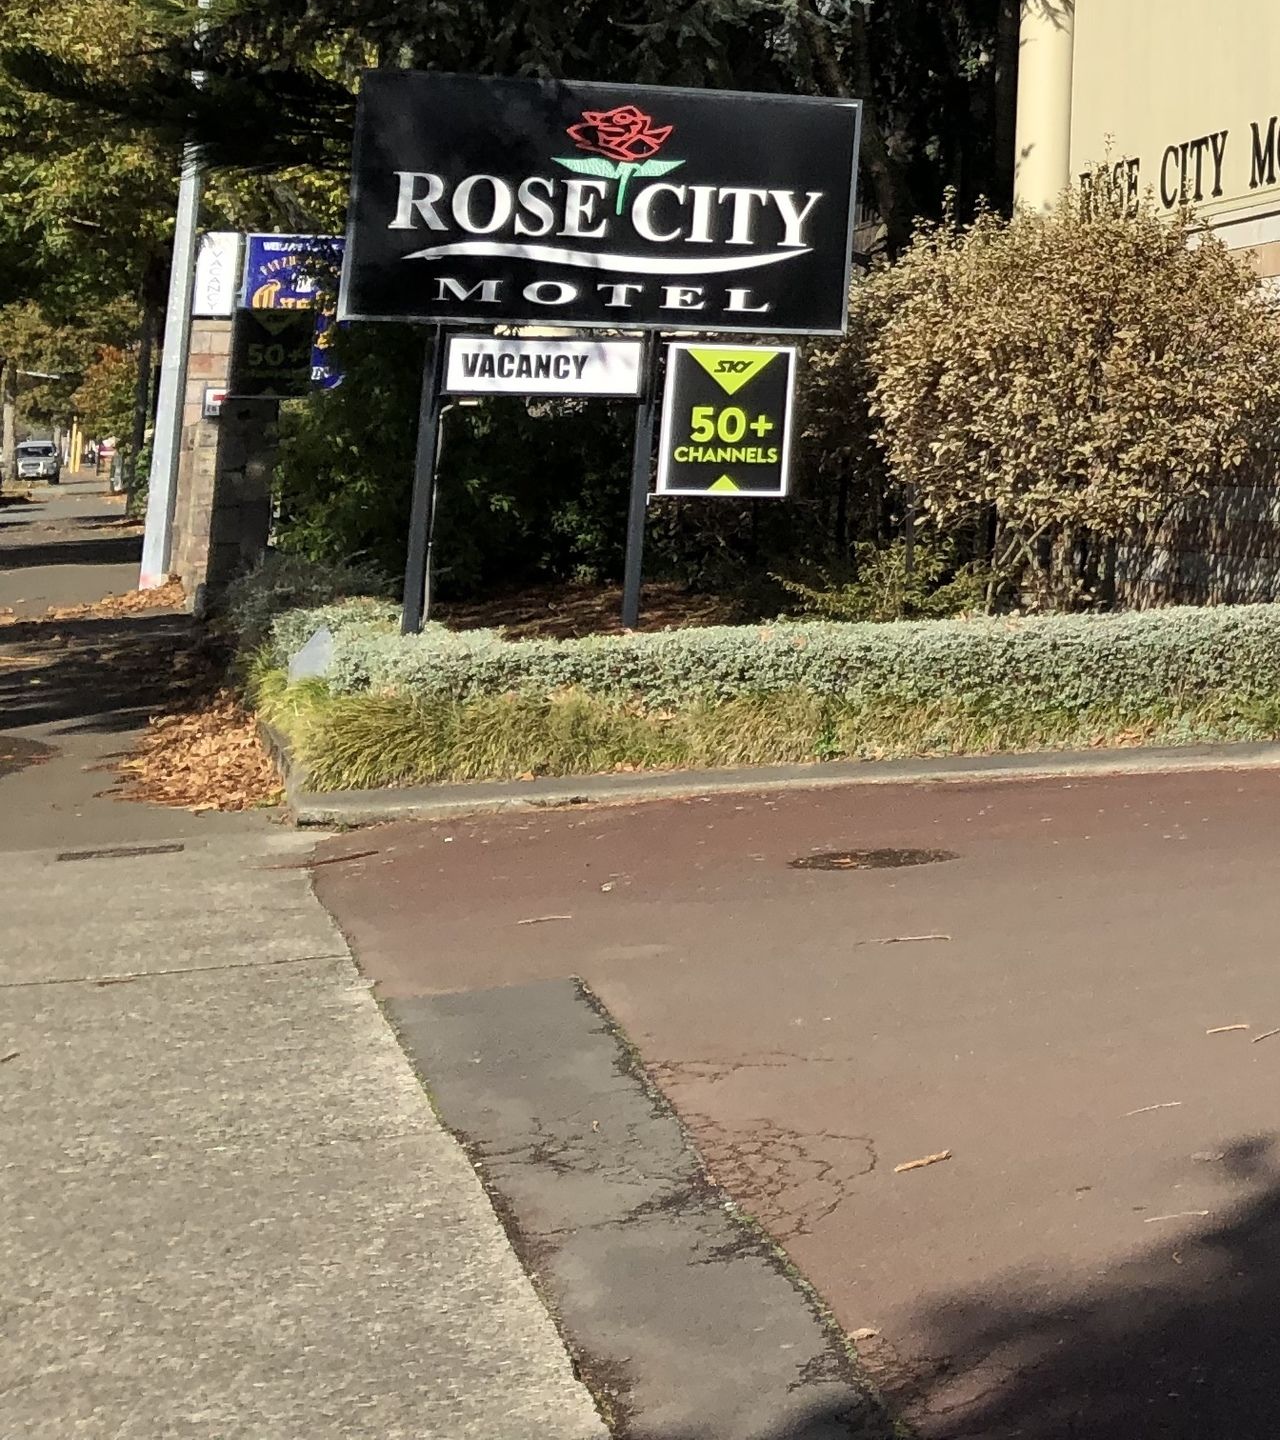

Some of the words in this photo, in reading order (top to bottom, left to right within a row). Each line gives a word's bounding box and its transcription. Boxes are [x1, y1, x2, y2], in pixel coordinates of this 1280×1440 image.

[1160, 130, 1229, 209] CITY
[388, 171, 608, 238] ROSE
[631, 182, 824, 247] CITY
[207, 250, 224, 310] VACANCY
[431, 277, 772, 312] MOTEL
[461, 352, 590, 379] VACANCY
[714, 359, 754, 373] SKY
[690, 407, 774, 442] 50+
[674, 445, 778, 464] CHANNELS
